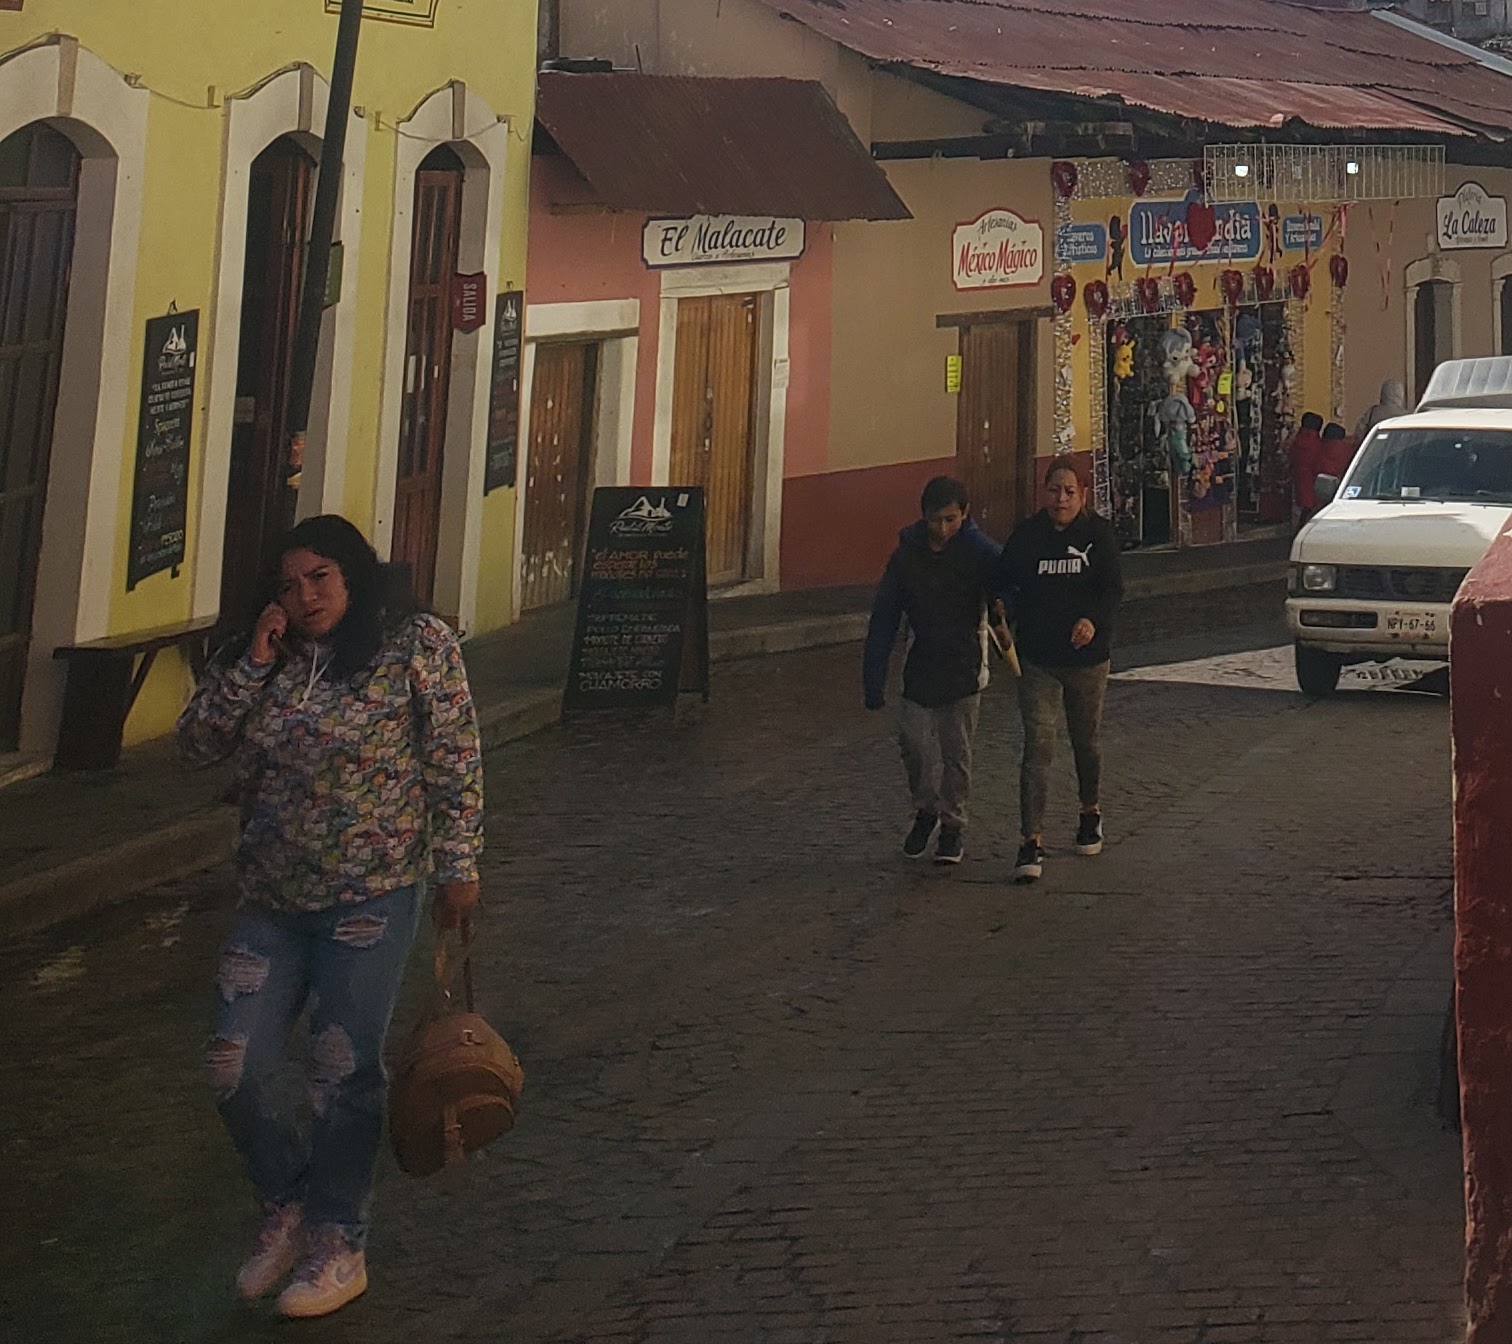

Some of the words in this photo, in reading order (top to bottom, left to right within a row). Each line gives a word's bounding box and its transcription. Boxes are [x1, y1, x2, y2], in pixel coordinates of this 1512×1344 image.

[660, 225, 690, 257] El
[691, 219, 787, 254] Malacate
[1442, 210, 1459, 240] La
[1461, 209, 1496, 235] Caleza
[958, 241, 996, 278] México
[995, 238, 1037, 275] Mágico
[462, 283, 477, 322] SALIDA
[1038, 558, 1081, 575] PUMA
